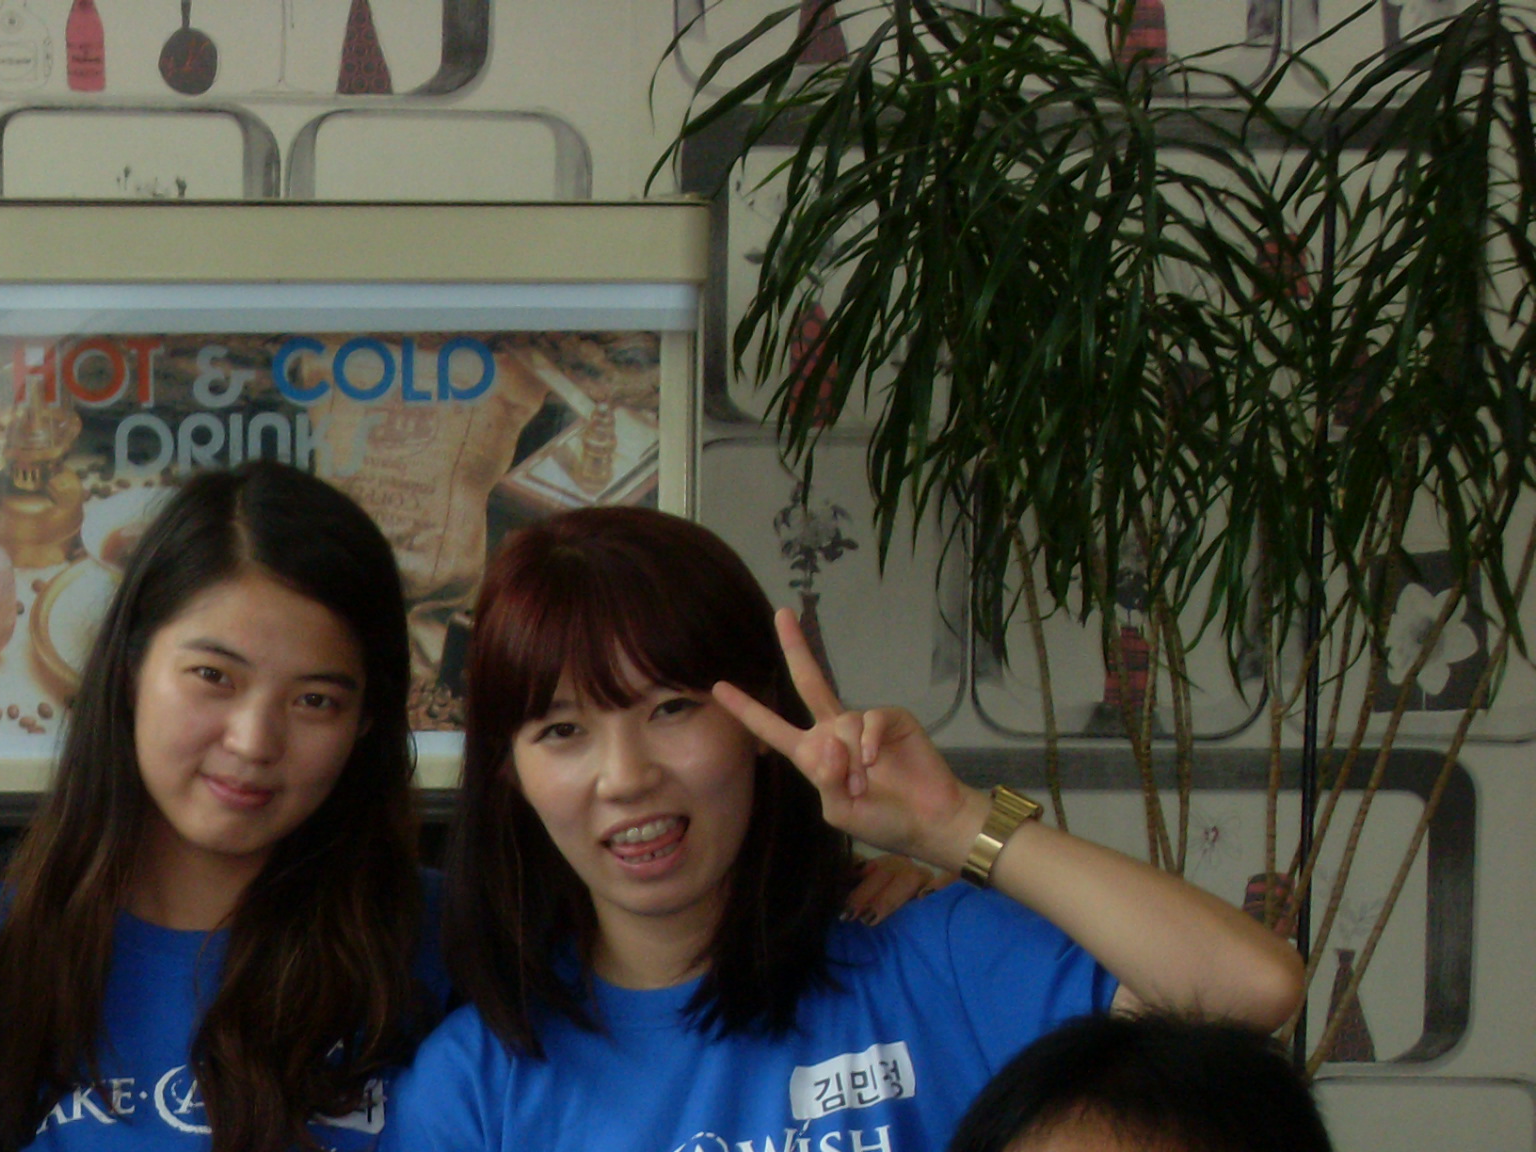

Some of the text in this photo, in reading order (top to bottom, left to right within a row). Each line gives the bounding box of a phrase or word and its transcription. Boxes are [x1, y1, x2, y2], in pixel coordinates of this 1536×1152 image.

[13, 336, 497, 408] HOT & COLD
[115, 412, 388, 478] DRINKS
